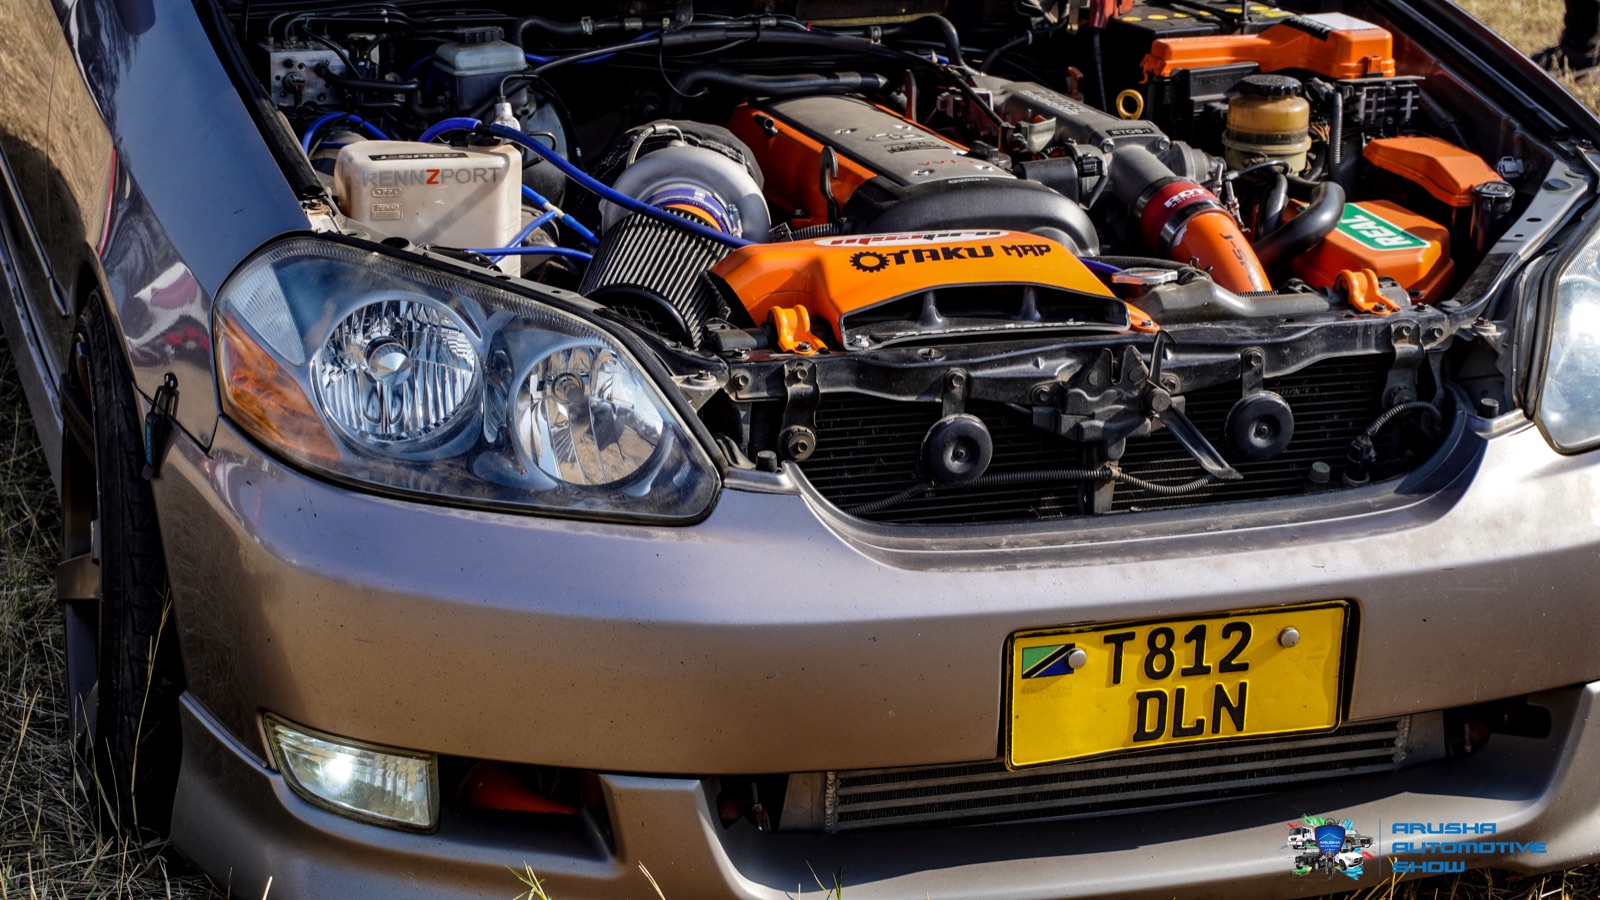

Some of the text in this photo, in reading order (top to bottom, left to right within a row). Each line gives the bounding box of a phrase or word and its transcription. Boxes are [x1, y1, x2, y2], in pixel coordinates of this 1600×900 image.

[361, 167, 502, 187] RENNZPORT
[1341, 215, 1413, 247] REAL
[849, 244, 1052, 273] OTAKU MAP
[1103, 621, 1253, 685] T812
[1132, 681, 1248, 742] DLN
